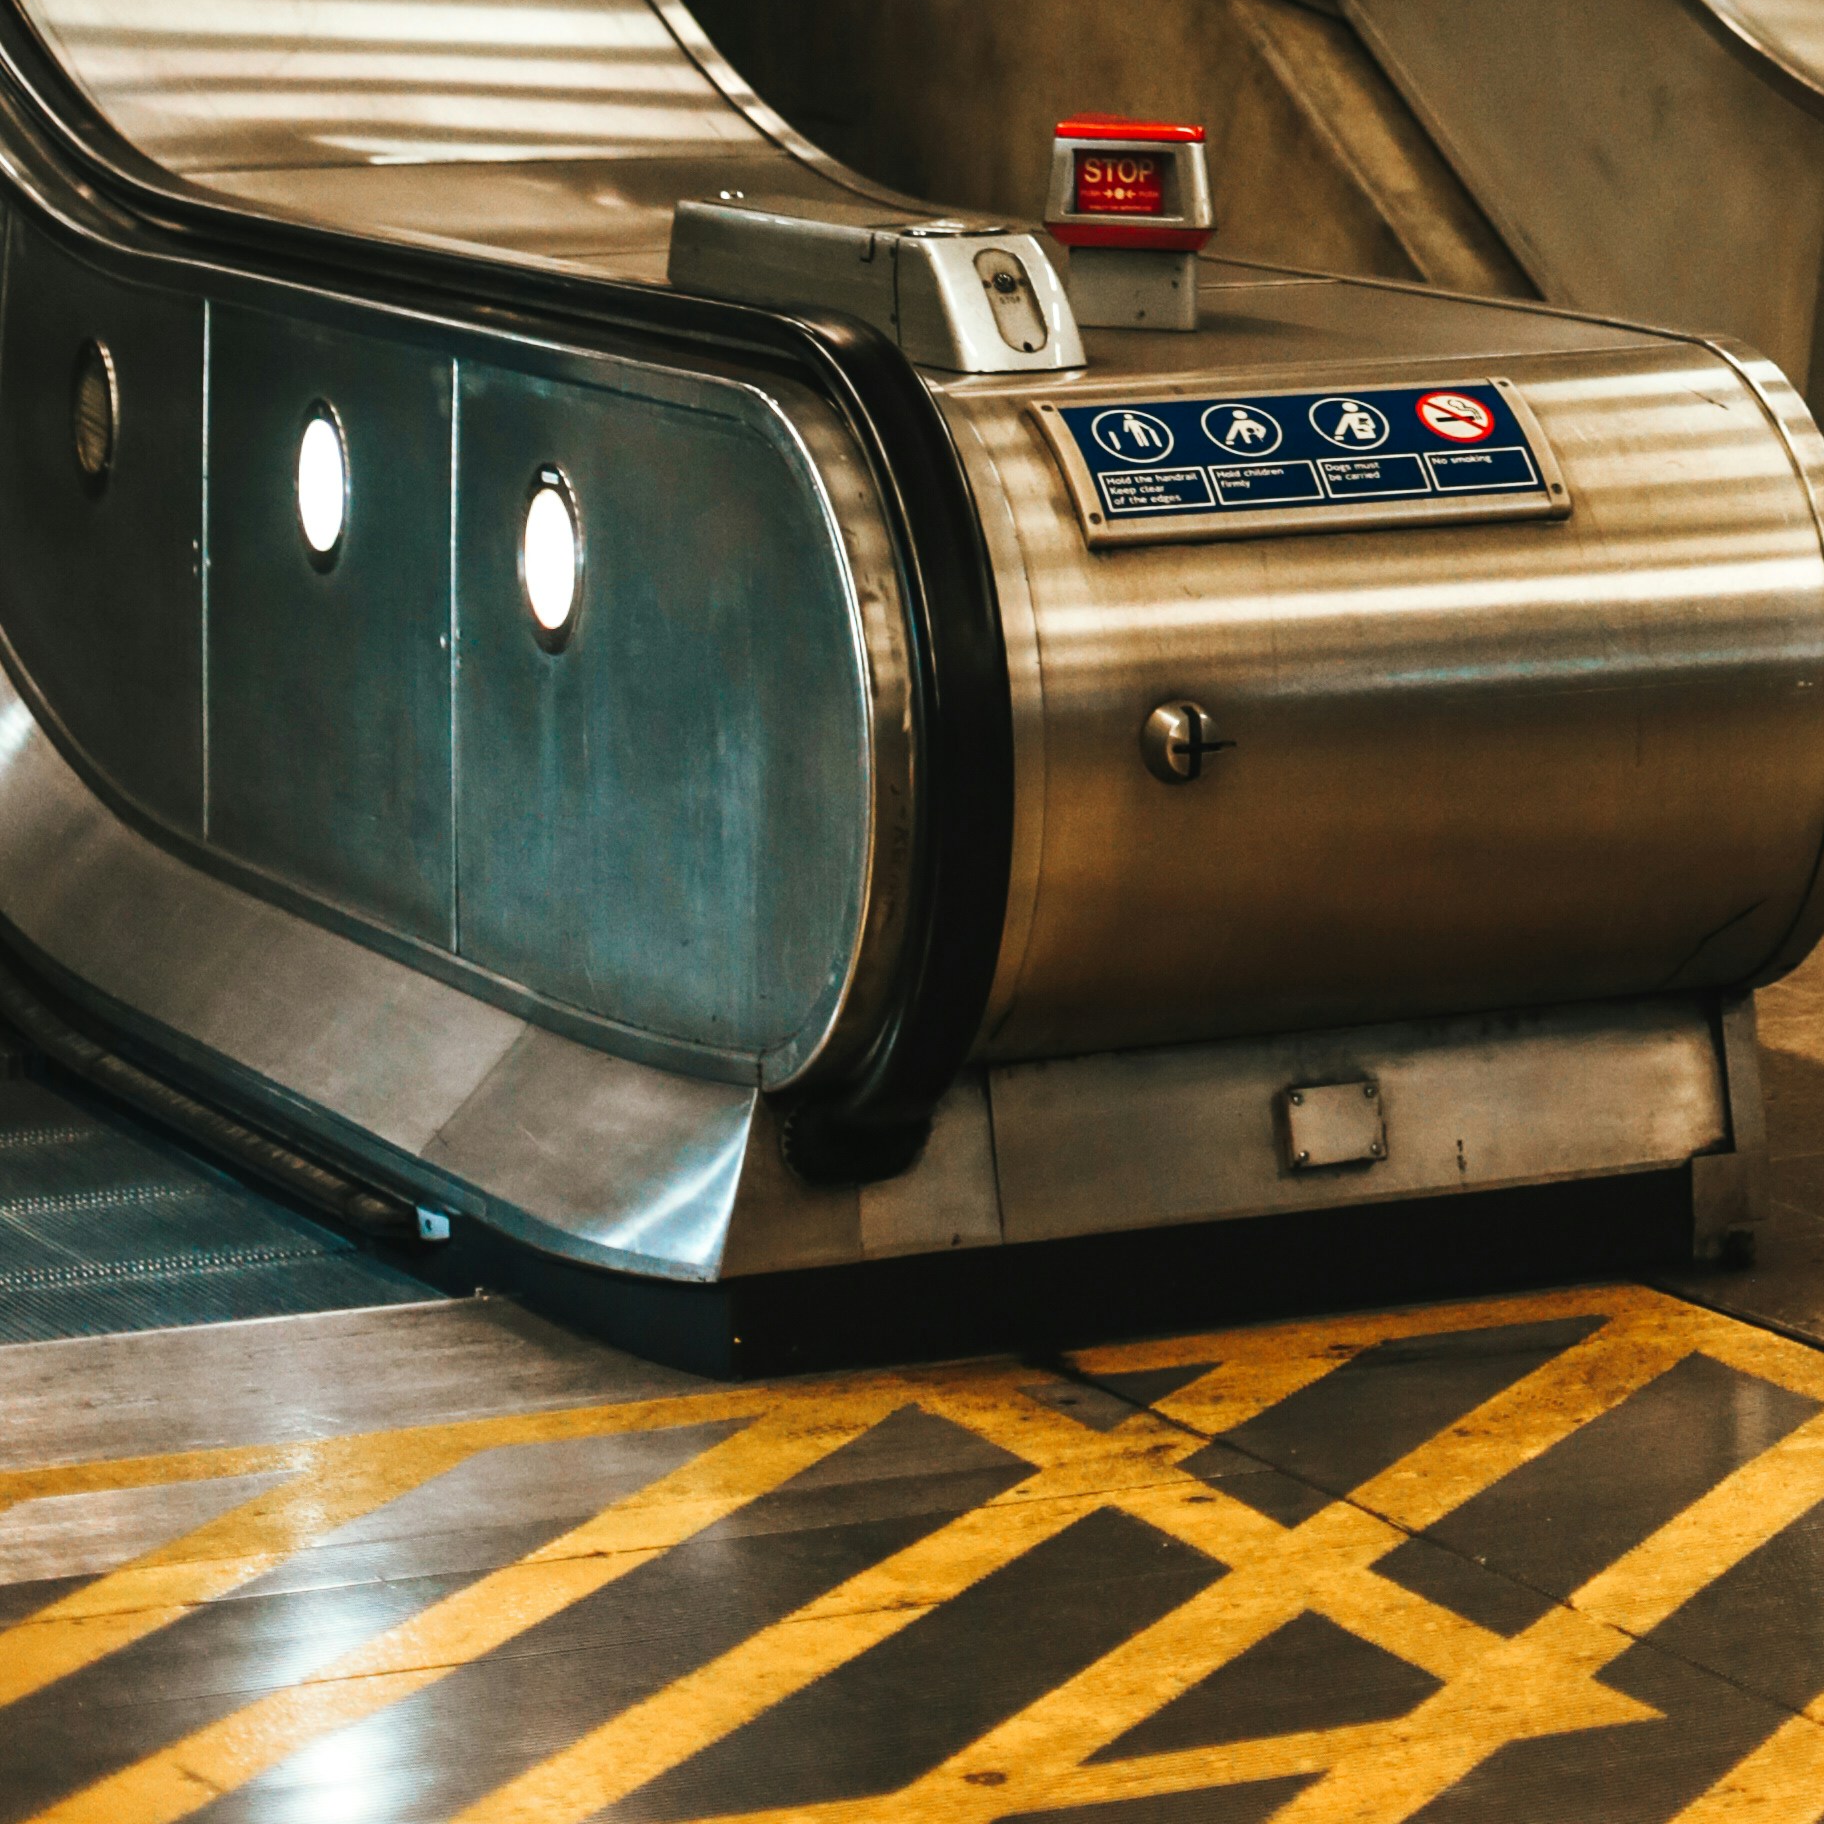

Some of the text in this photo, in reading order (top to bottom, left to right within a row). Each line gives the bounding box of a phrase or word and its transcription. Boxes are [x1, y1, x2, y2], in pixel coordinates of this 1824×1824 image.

[1084, 158, 1154, 183] STOP
[1431, 454, 1492, 465] No smoking
[1216, 467, 1284, 478] Hold children
[1325, 461, 1380, 473] Dogs must
[1106, 472, 1197, 486] Hold the handrail
[1329, 470, 1381, 481] be carried
[1110, 484, 1165, 496] Keep clear
[1221, 479, 1251, 489] firmly
[1114, 494, 1181, 506] of the edges
